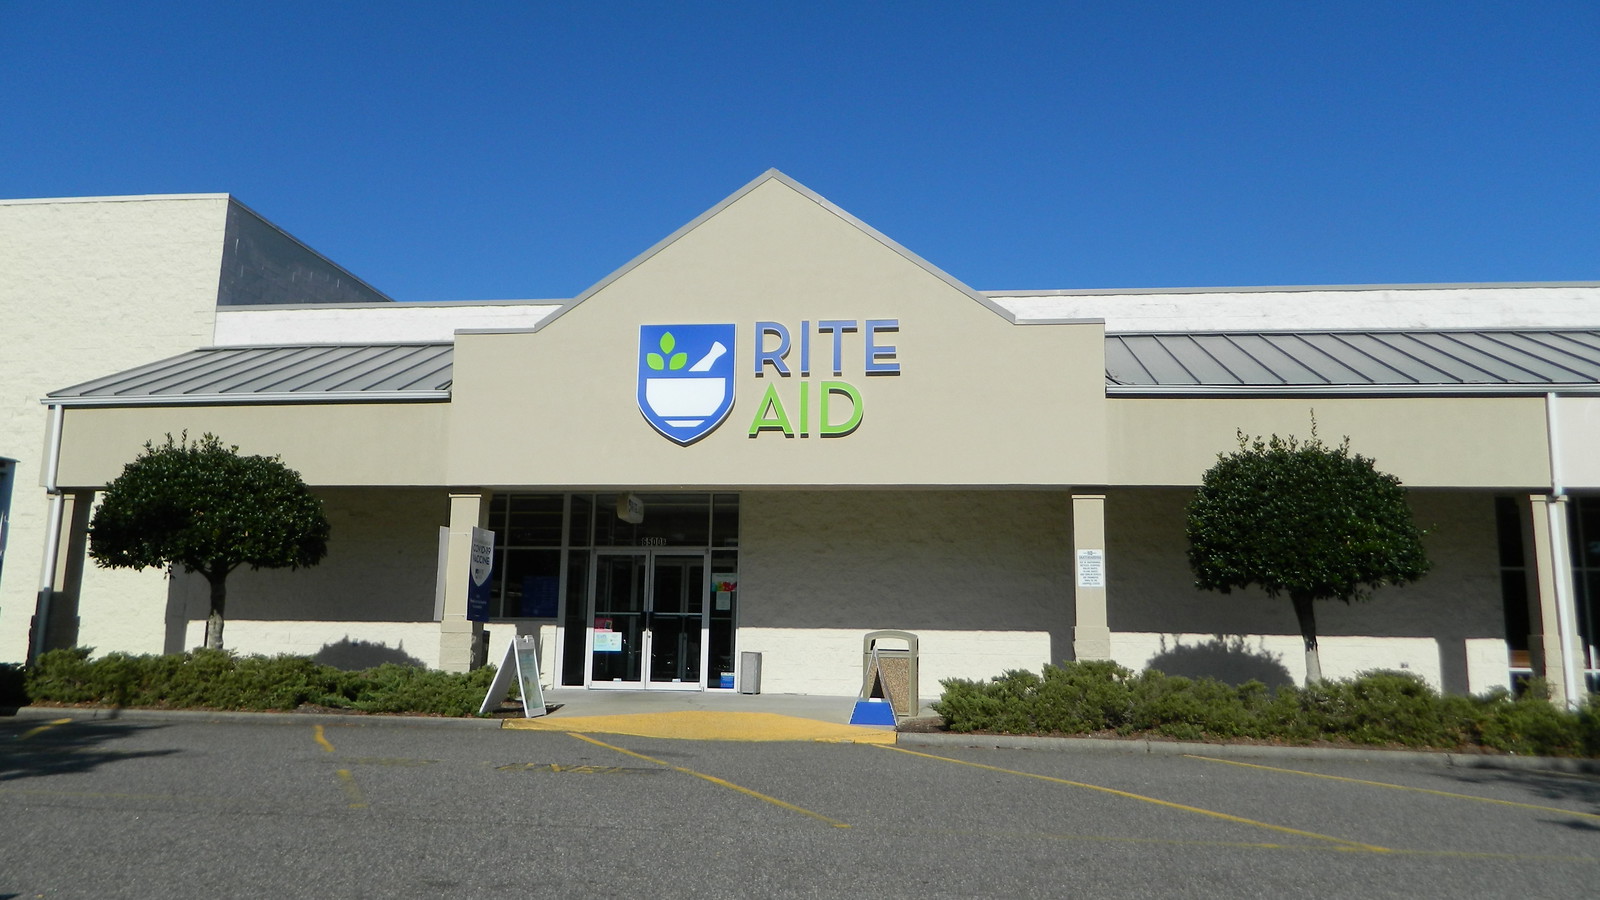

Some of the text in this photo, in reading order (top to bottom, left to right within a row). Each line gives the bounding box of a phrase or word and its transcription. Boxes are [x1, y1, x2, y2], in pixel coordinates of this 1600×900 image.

[754, 319, 901, 377] RITE
[748, 380, 864, 438] AID
[473, 544, 491, 555] COVID-19
[473, 554, 490, 565] VACCINE
